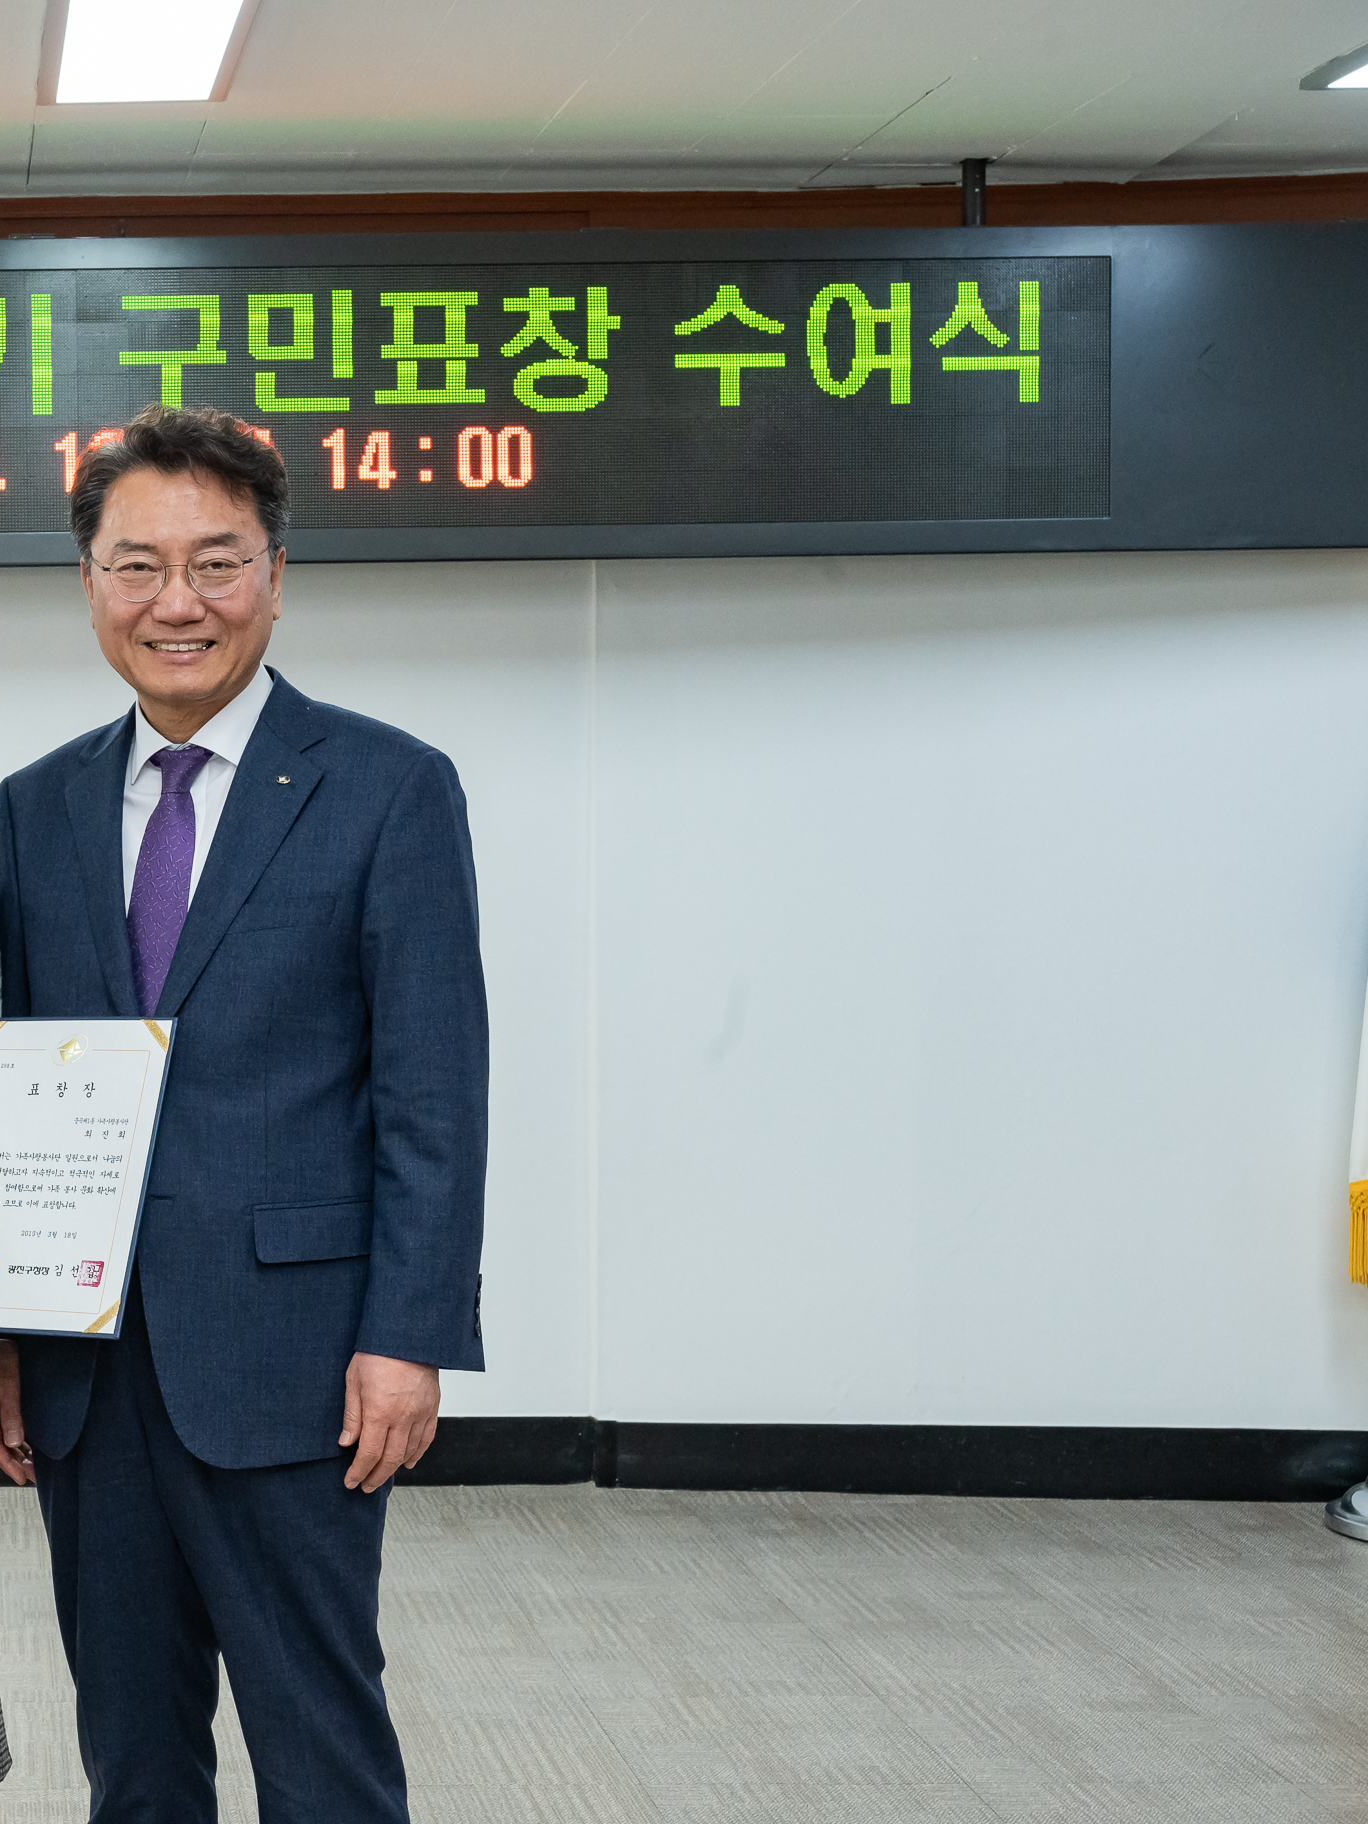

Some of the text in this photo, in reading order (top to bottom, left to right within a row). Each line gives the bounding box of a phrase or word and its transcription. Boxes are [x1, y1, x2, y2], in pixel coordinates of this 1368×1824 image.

[119, 287, 621, 412] 구민표창
[674, 281, 1040, 406] 수여식
[15, 1151, 62, 1163] 가족사랑봉사단
[65, 1153, 99, 1163] 일원으로서
[102, 1154, 123, 1164] 나눔의
[31, 1168, 65, 1178] 지속적이고
[69, 1169, 96, 1180] 적극적인
[99, 1170, 120, 1180] 자세로
[4, 1182, 44, 1193] 참여함으로써
[47, 1184, 61, 1194] 가족
[63, 1185, 78, 1195] 봉사
[79, 1185, 94, 1196] 문화
[96, 1185, 117, 1196] 확산에
[2, 1199, 23, 1208] 크므로
[25, 1199, 40, 1209] 이에
[41, 1200, 77, 1210] 표창합니다.
[7, 1264, 51, 1276] 광진구청장
